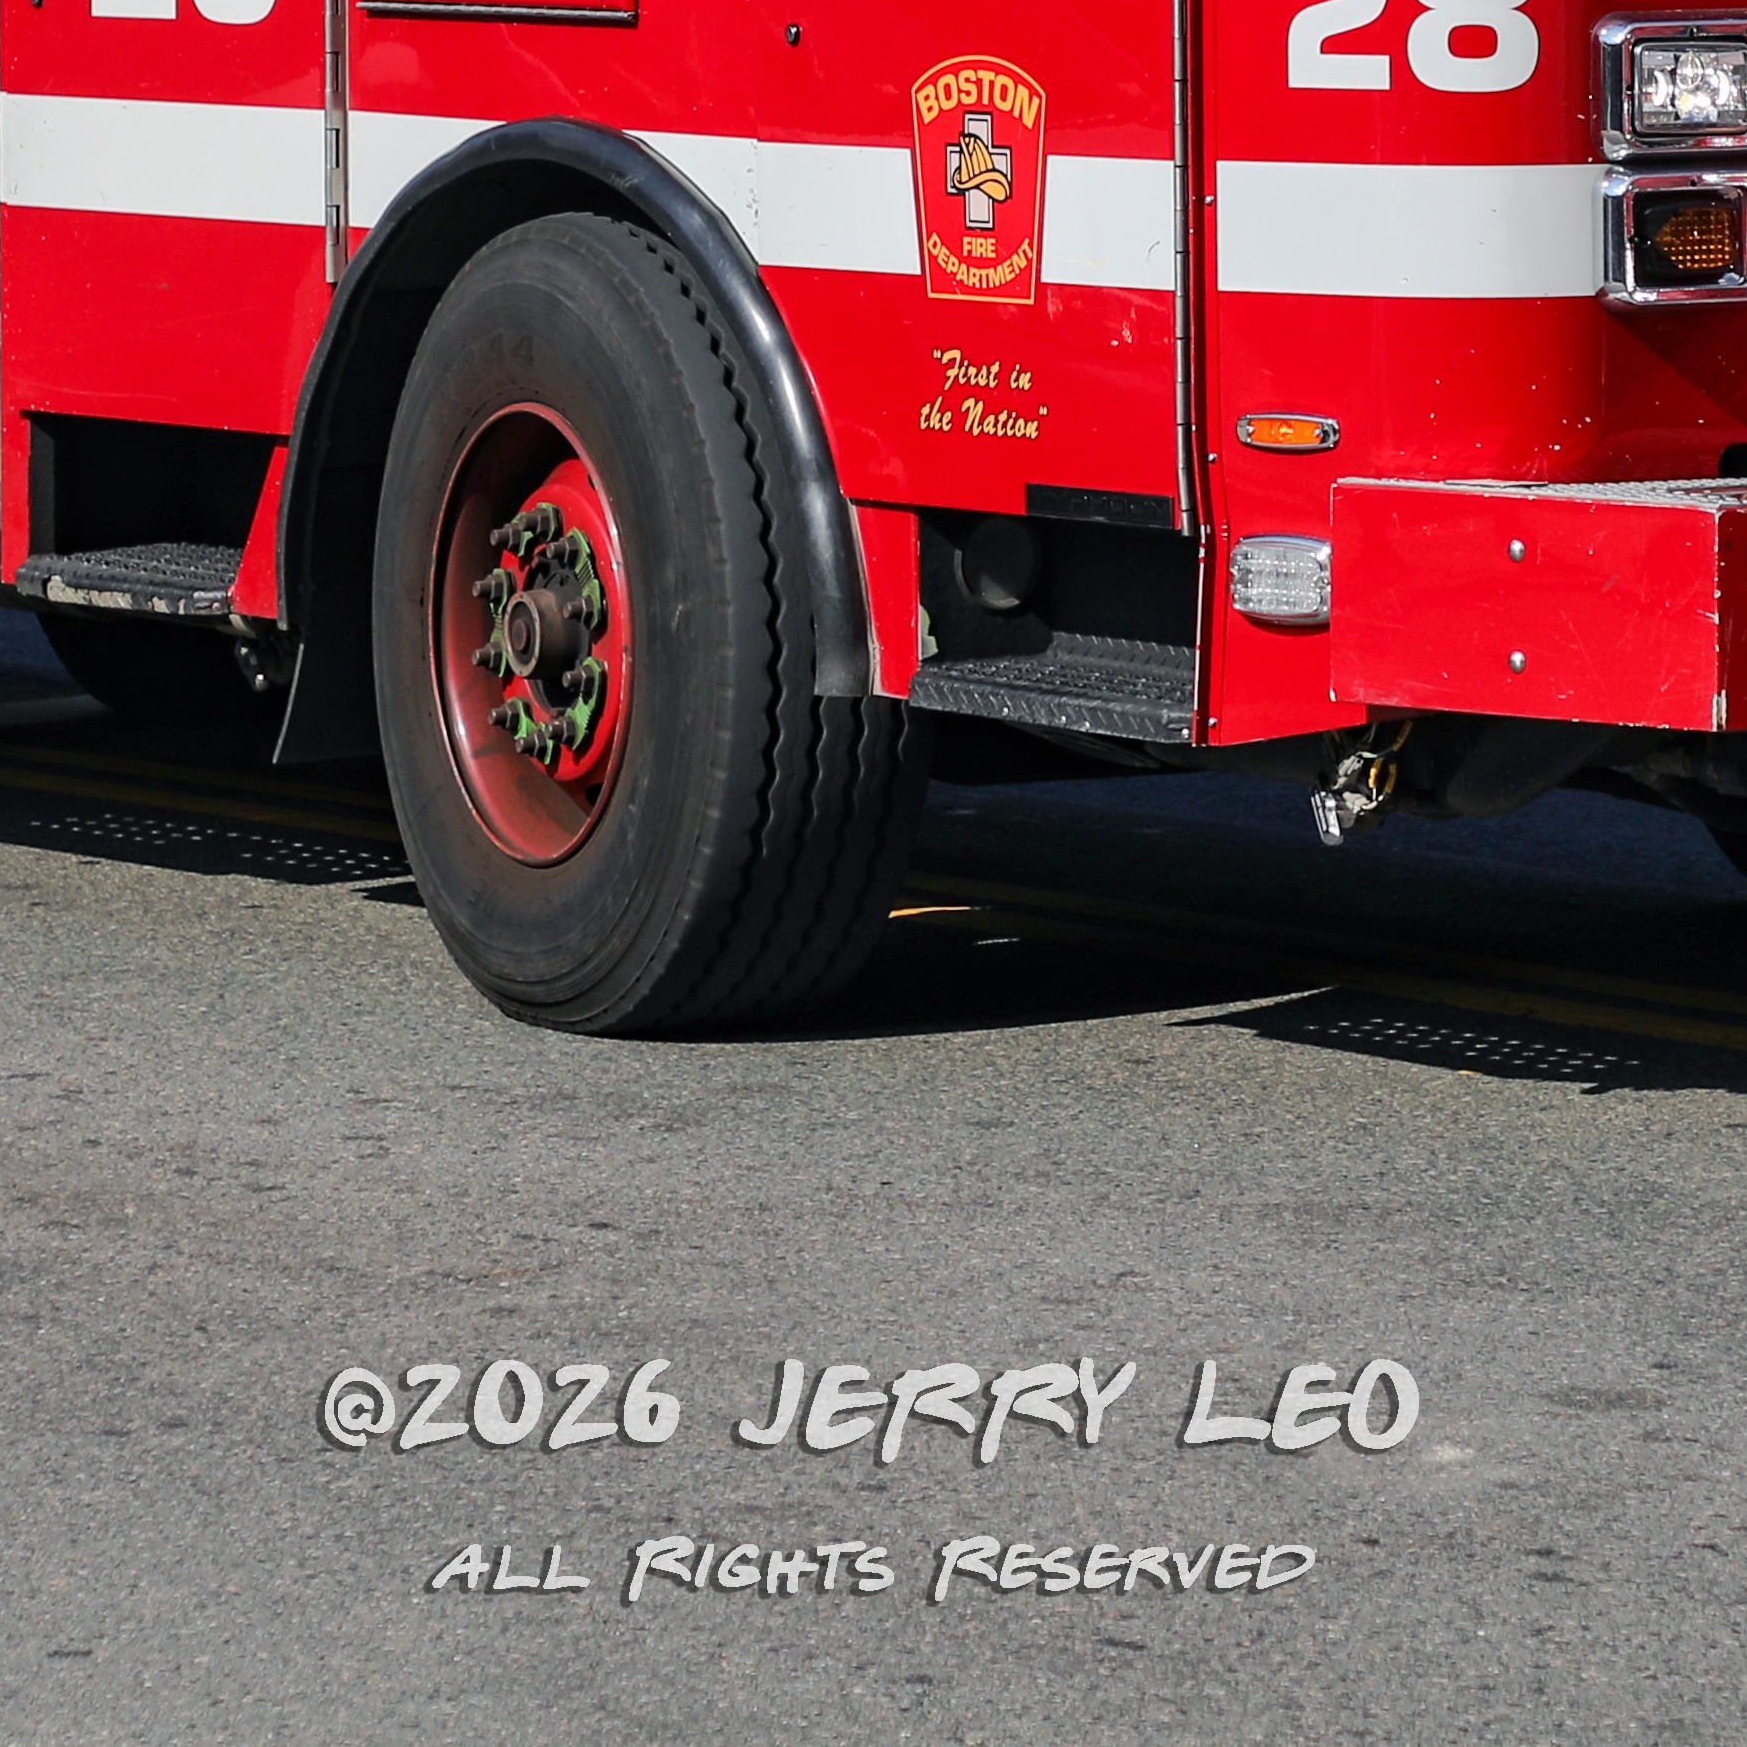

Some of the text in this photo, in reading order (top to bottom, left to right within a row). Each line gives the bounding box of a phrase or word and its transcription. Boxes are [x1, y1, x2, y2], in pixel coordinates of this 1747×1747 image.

[915, 68, 1040, 130] BOSTON
[927, 231, 1035, 290] DEPARTMENT
[962, 235, 997, 259] FIRE
[932, 348, 1033, 391] "First in
[919, 396, 1048, 440] the Nation"
